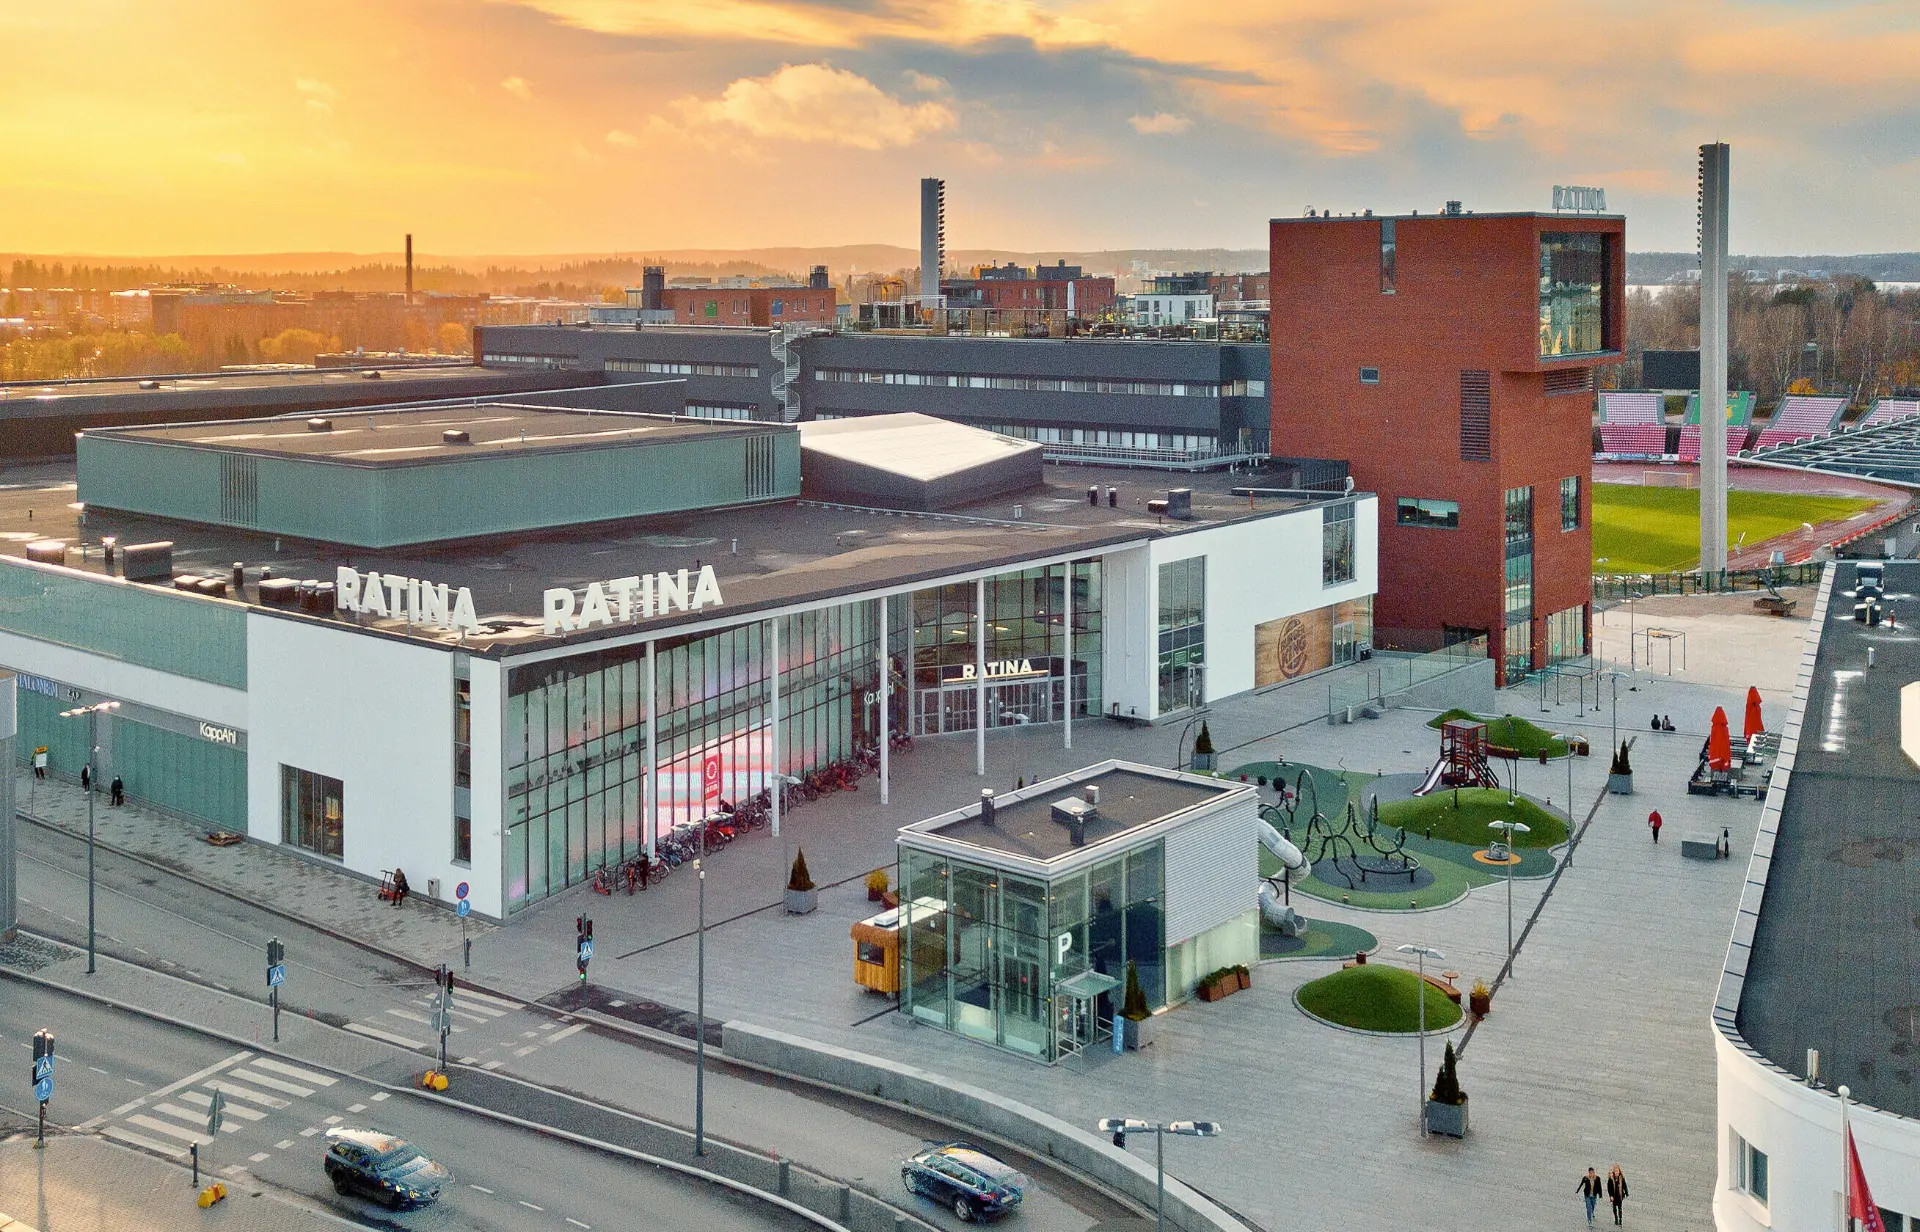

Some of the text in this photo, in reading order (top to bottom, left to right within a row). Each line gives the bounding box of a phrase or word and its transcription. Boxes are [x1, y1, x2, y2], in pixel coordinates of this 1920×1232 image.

[1552, 185, 1606, 210] RATINA
[337, 566, 479, 634] RATINA
[544, 565, 723, 635] RATINA
[200, 722, 236, 744] KappAhl
[1058, 932, 1072, 964] P
